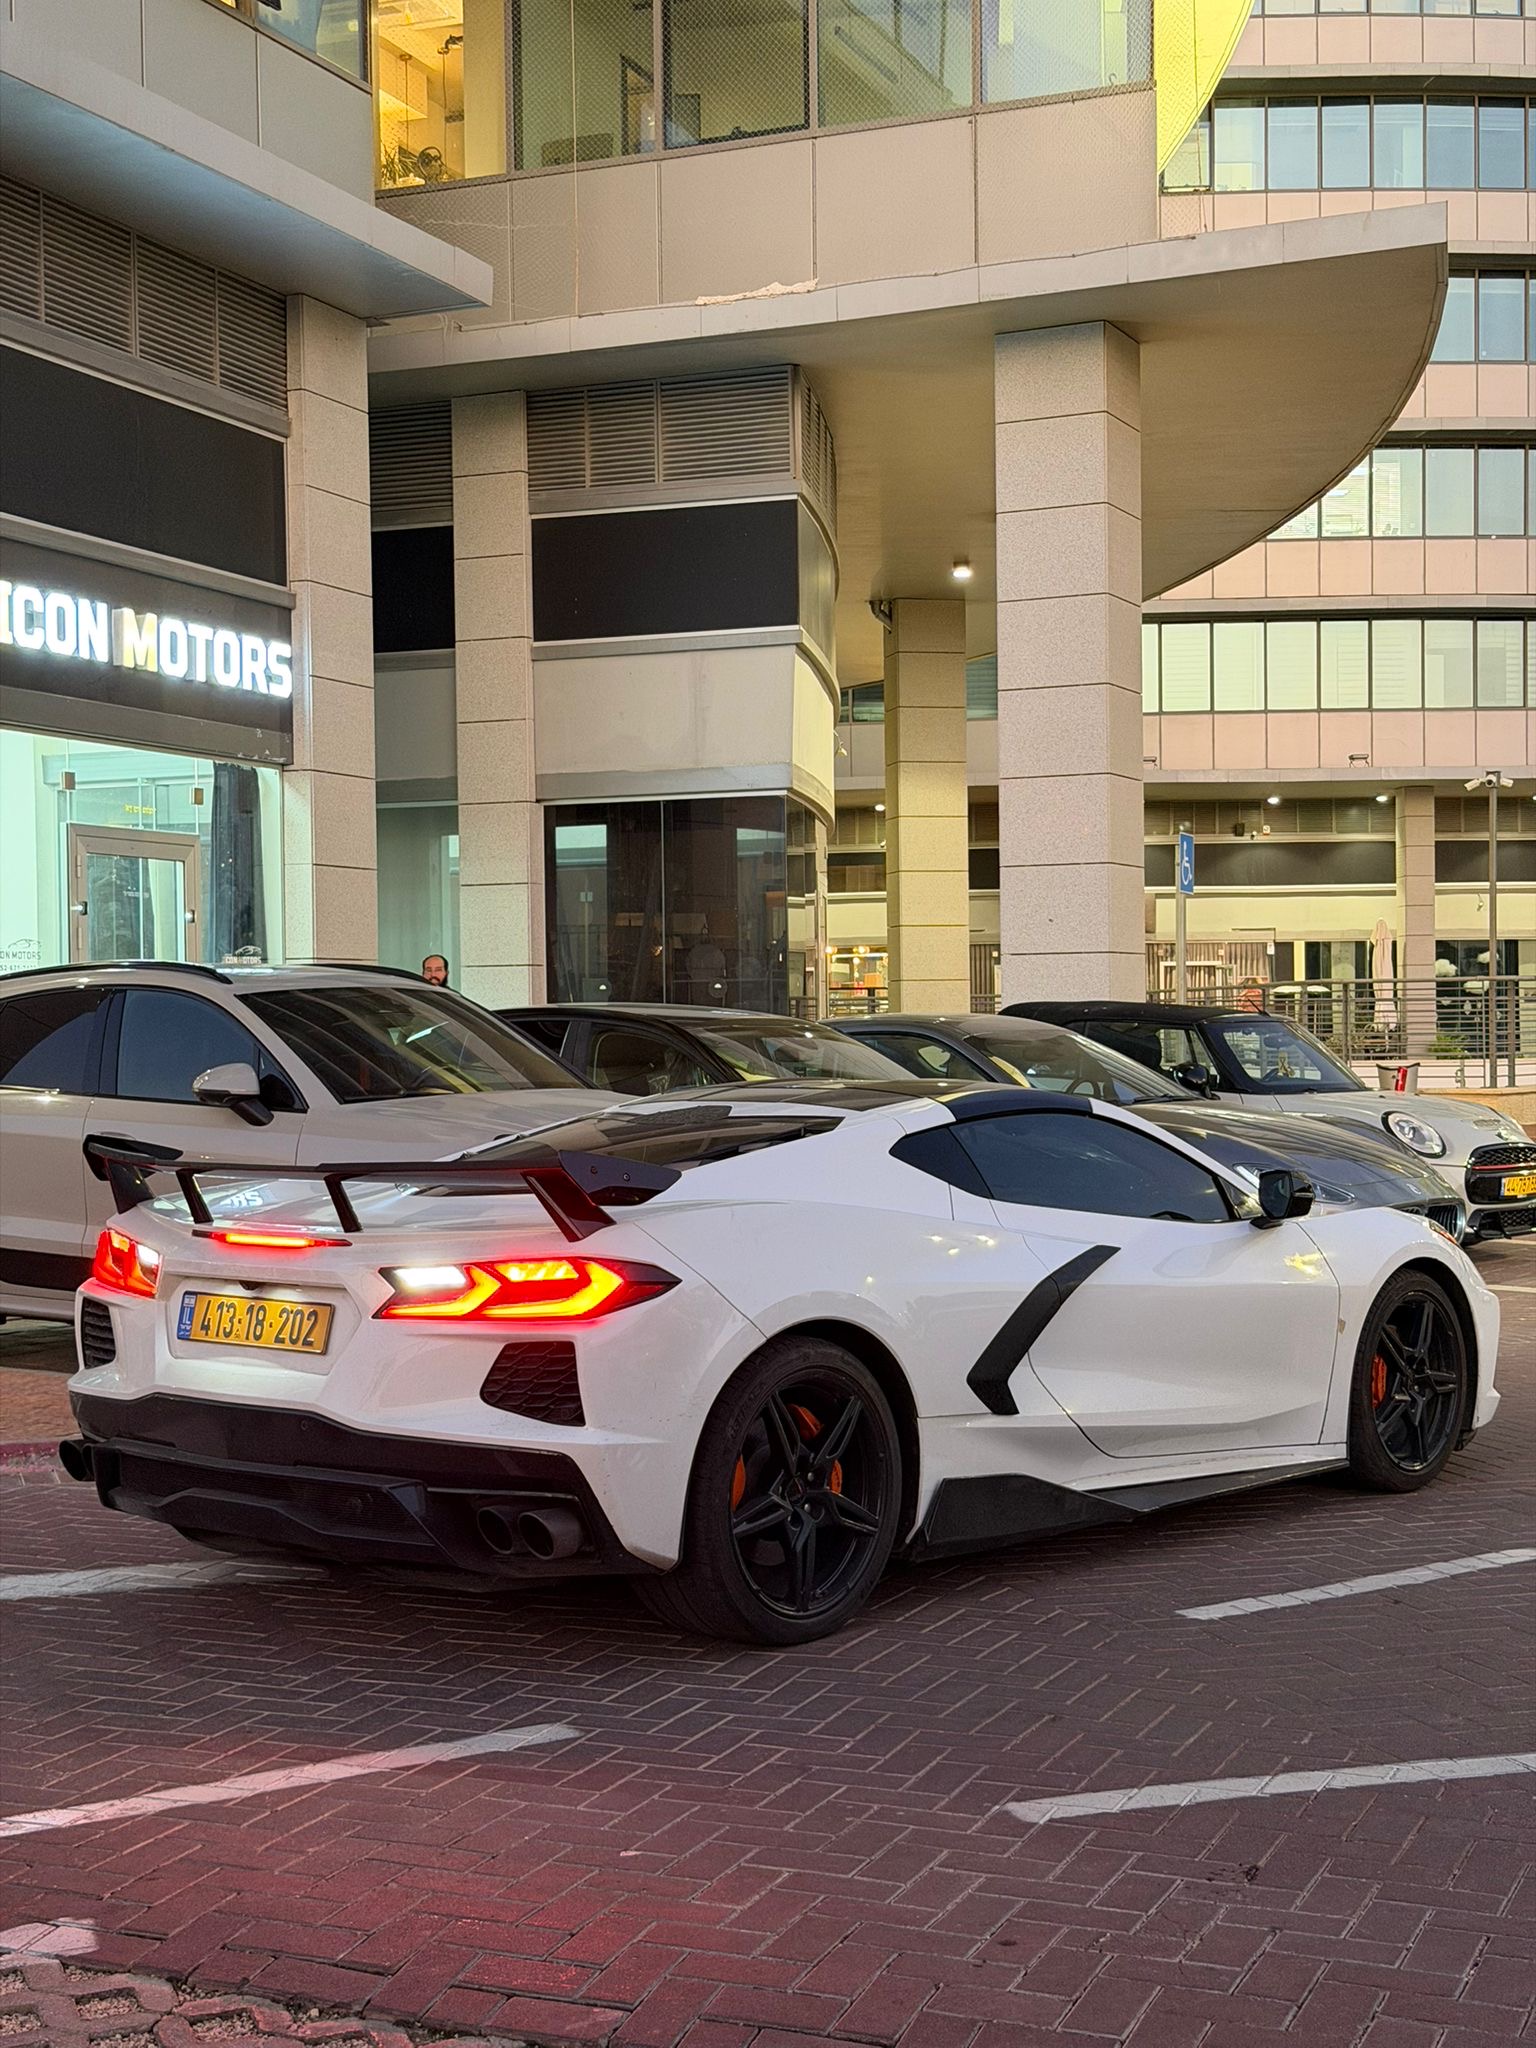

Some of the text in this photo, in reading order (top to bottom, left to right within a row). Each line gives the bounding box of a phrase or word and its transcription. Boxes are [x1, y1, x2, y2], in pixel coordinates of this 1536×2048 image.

[0, 580, 293, 698] ICON MOTORS
[12, 951, 41, 960] MOTORS
